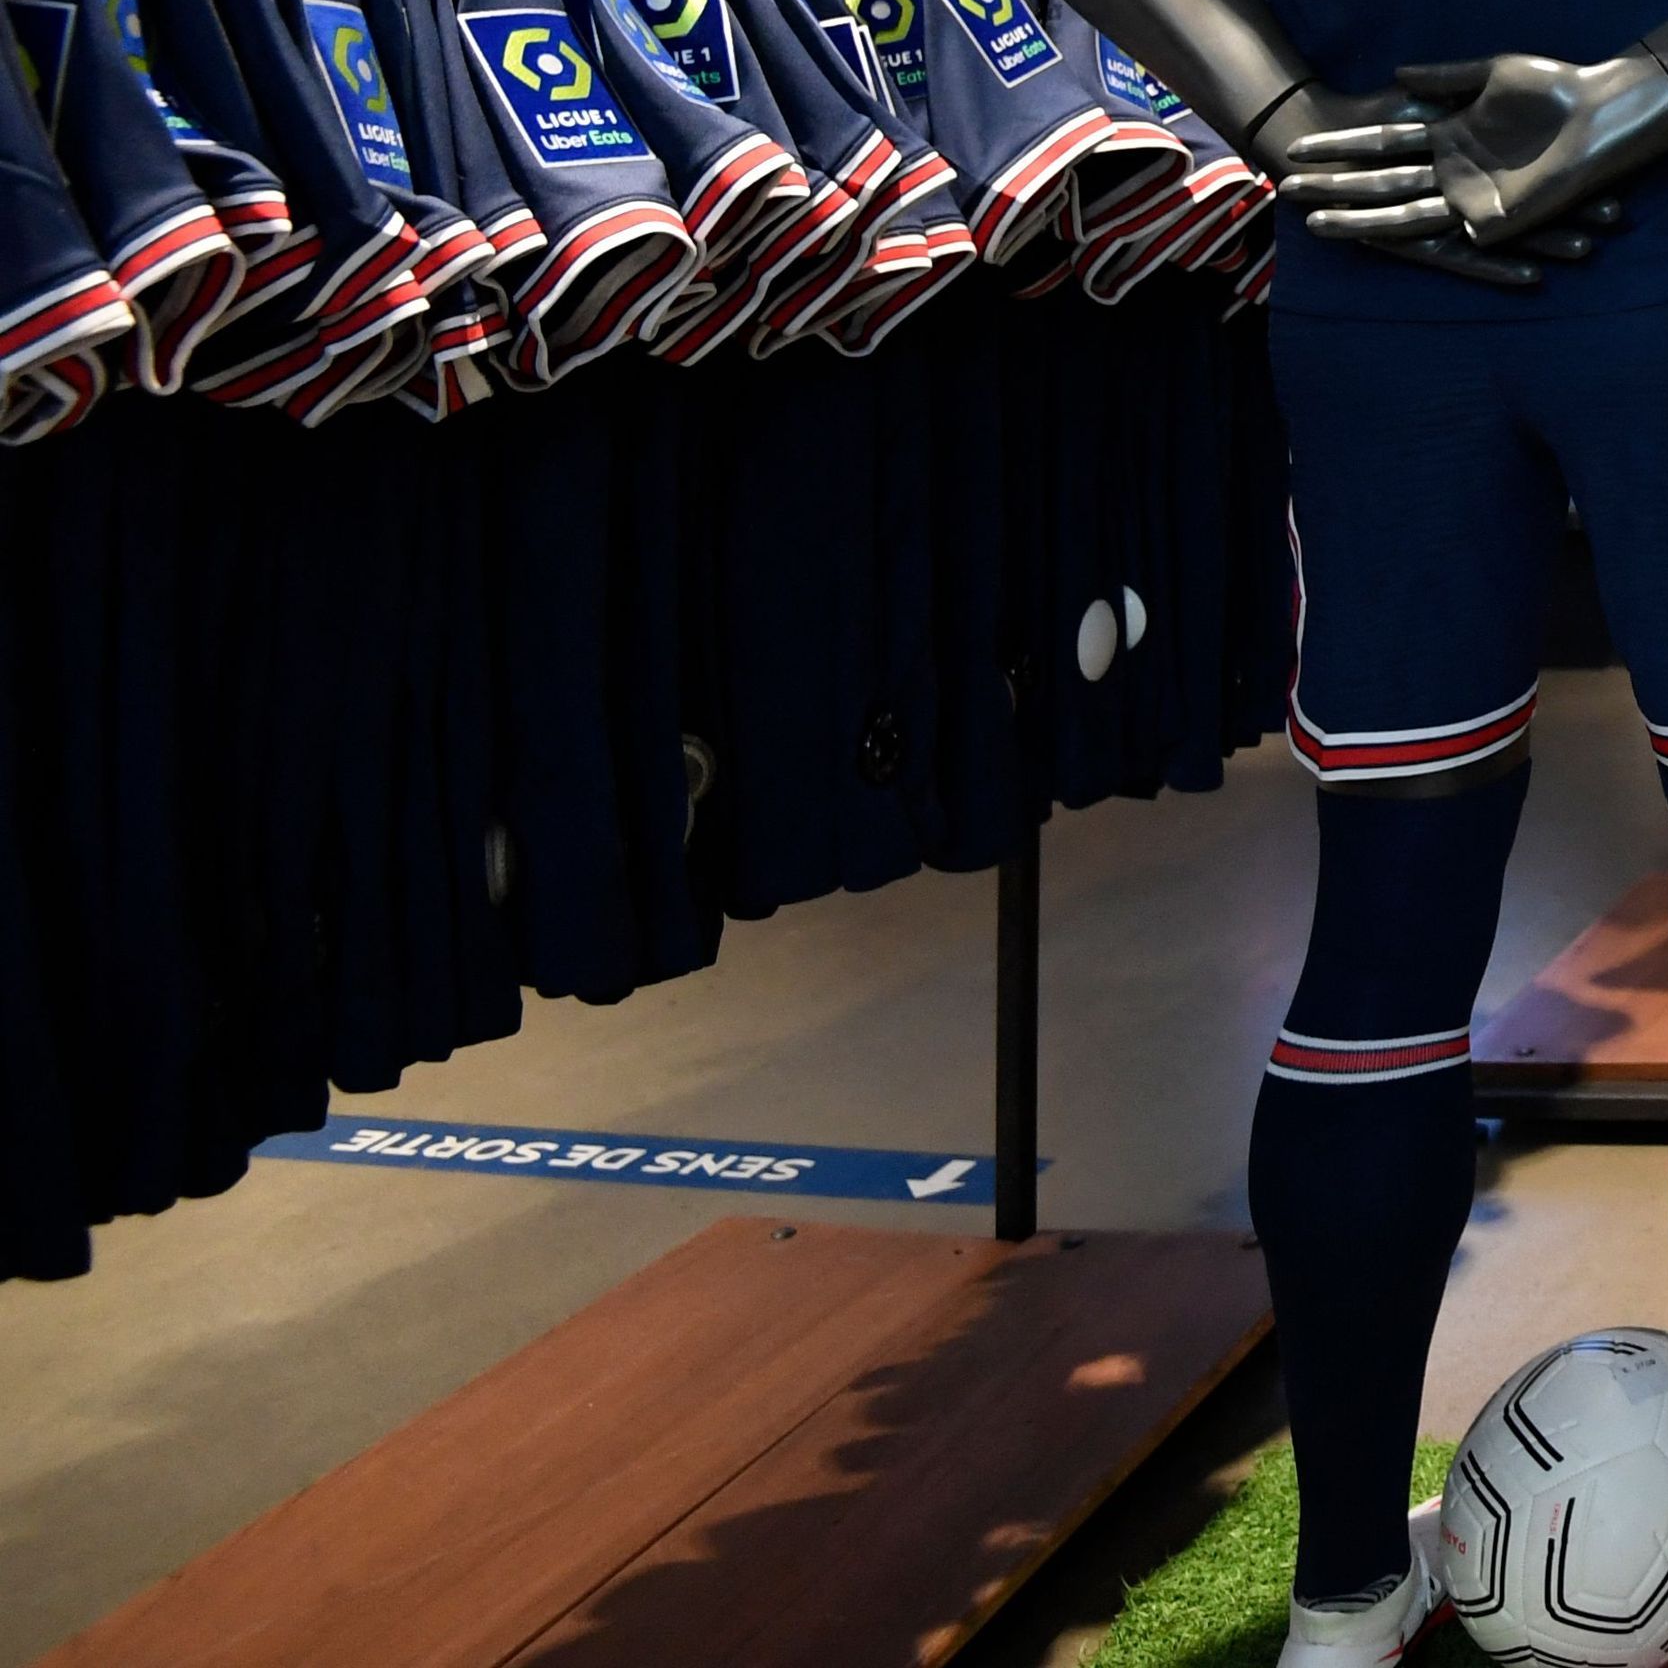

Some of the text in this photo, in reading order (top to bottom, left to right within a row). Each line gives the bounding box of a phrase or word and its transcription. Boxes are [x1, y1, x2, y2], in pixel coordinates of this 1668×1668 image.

[990, 25, 1028, 54] LIGUE
[536, 109, 617, 130] LIGUE 1
[540, 130, 634, 150] Uber Eats
[330, 1129, 814, 1181] SENS DE SORTIE
